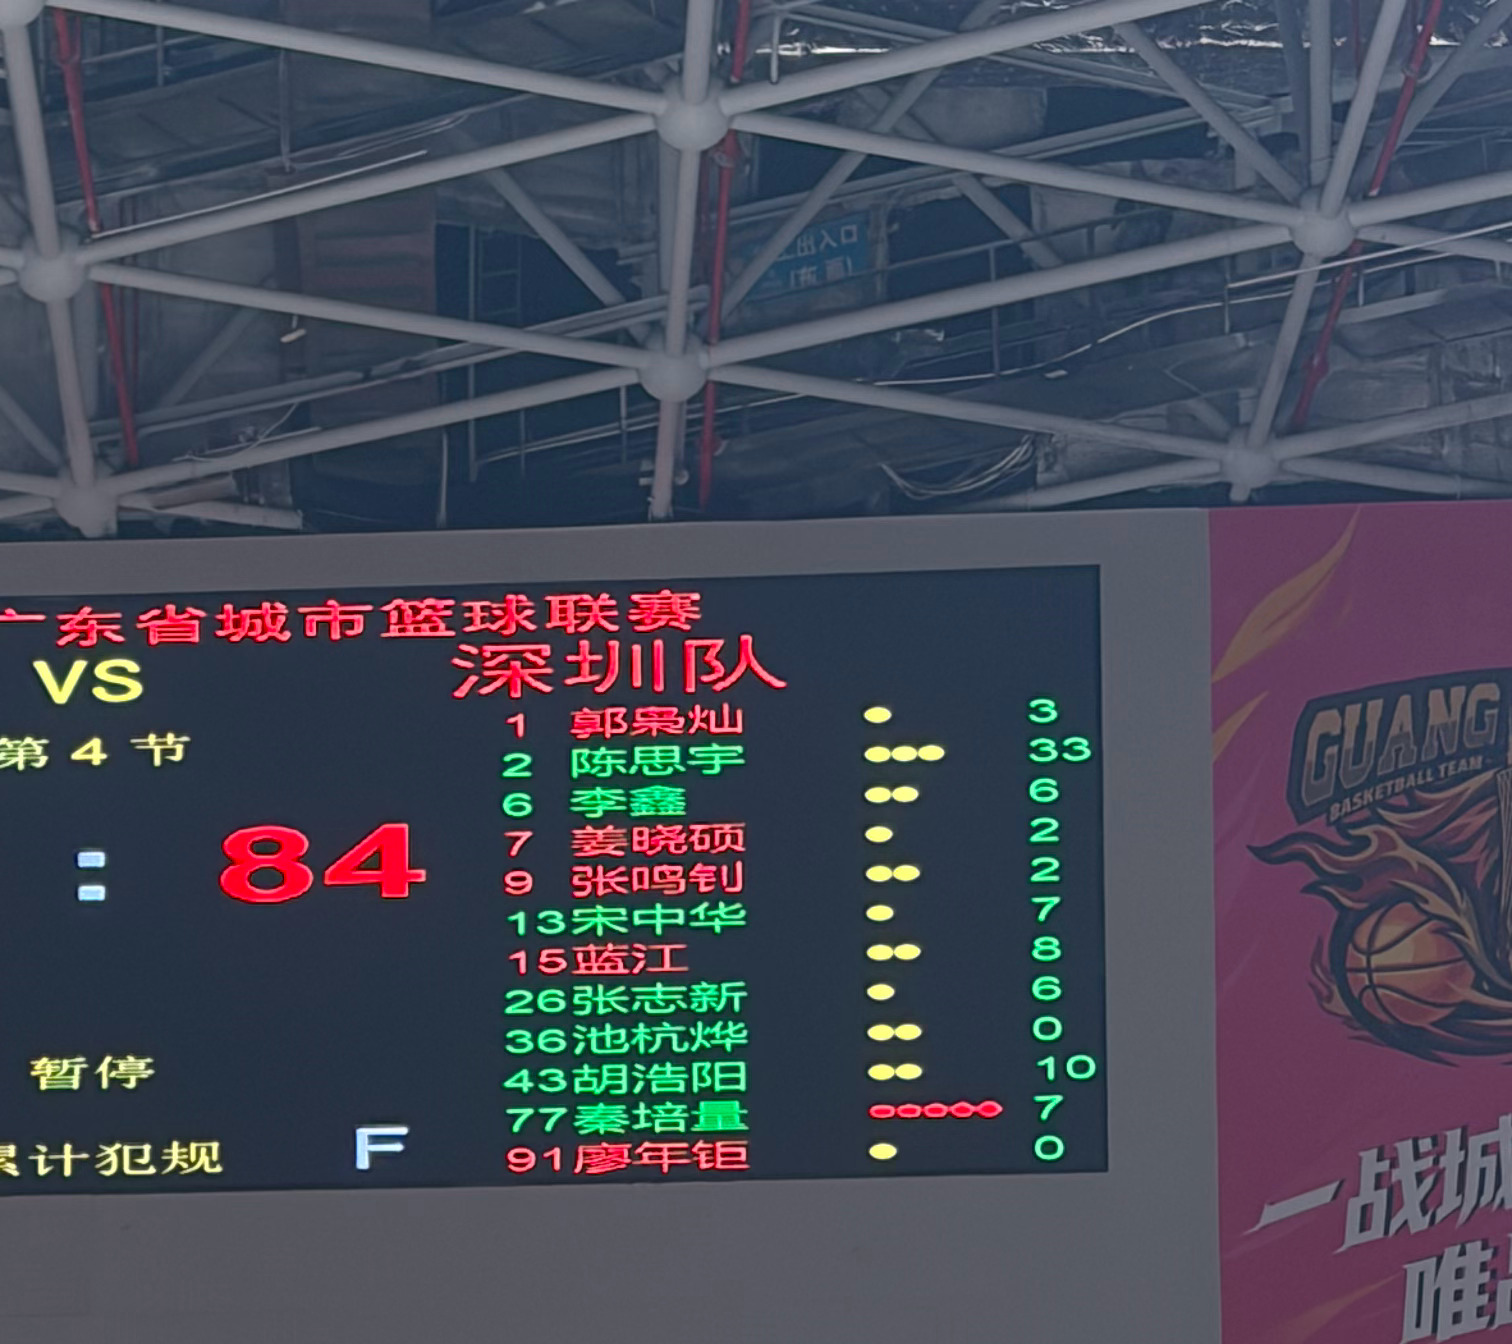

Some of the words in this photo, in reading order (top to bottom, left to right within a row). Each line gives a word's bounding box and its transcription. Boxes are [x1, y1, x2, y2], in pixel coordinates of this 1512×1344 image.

[32, 658, 143, 705] VS
[450, 634, 788, 699] 深圳队
[506, 713, 525, 738] 1
[1028, 698, 1058, 724] 3
[502, 752, 532, 778] 2
[571, 742, 745, 779] 陈思宇
[1029, 736, 1092, 763] 33
[1302, 683, 1501, 805] GUANG
[502, 792, 533, 817] 6
[570, 784, 686, 819] 李鑫
[1029, 777, 1059, 803] 6
[1329, 772, 1435, 823] BASKETBALL
[1437, 755, 1485, 782] TEAM
[504, 830, 533, 857] 7
[571, 823, 746, 857] 姜晓硕
[1029, 817, 1060, 843] 2
[219, 823, 427, 903] 84
[503, 870, 533, 895] 9
[571, 860, 743, 898] 张鸣钊
[1030, 856, 1060, 882] 2
[507, 910, 566, 936] 13
[571, 901, 747, 937] 宋中华
[1031, 896, 1061, 922] 7
[509, 948, 568, 975] 15
[571, 942, 688, 975] 蓝江
[1031, 935, 1062, 962] 8
[504, 988, 567, 1015] 26
[572, 981, 748, 1016] 张志新
[1031, 975, 1062, 1001] 6
[505, 1028, 567, 1054] 36
[572, 1020, 748, 1055] 池杭烨
[1032, 1015, 1063, 1041] 0
[30, 1054, 155, 1091] 暂停
[503, 1067, 568, 1094] 43
[571, 1061, 747, 1095] 胡浩阳
[1037, 1054, 1096, 1081] 10
[505, 1107, 568, 1133] 77
[1033, 1094, 1064, 1121] 7
[355, 1126, 409, 1170] F
[506, 1147, 561, 1173] 91
[573, 1139, 750, 1175] 廖年钜
[1034, 1135, 1065, 1161] 0
